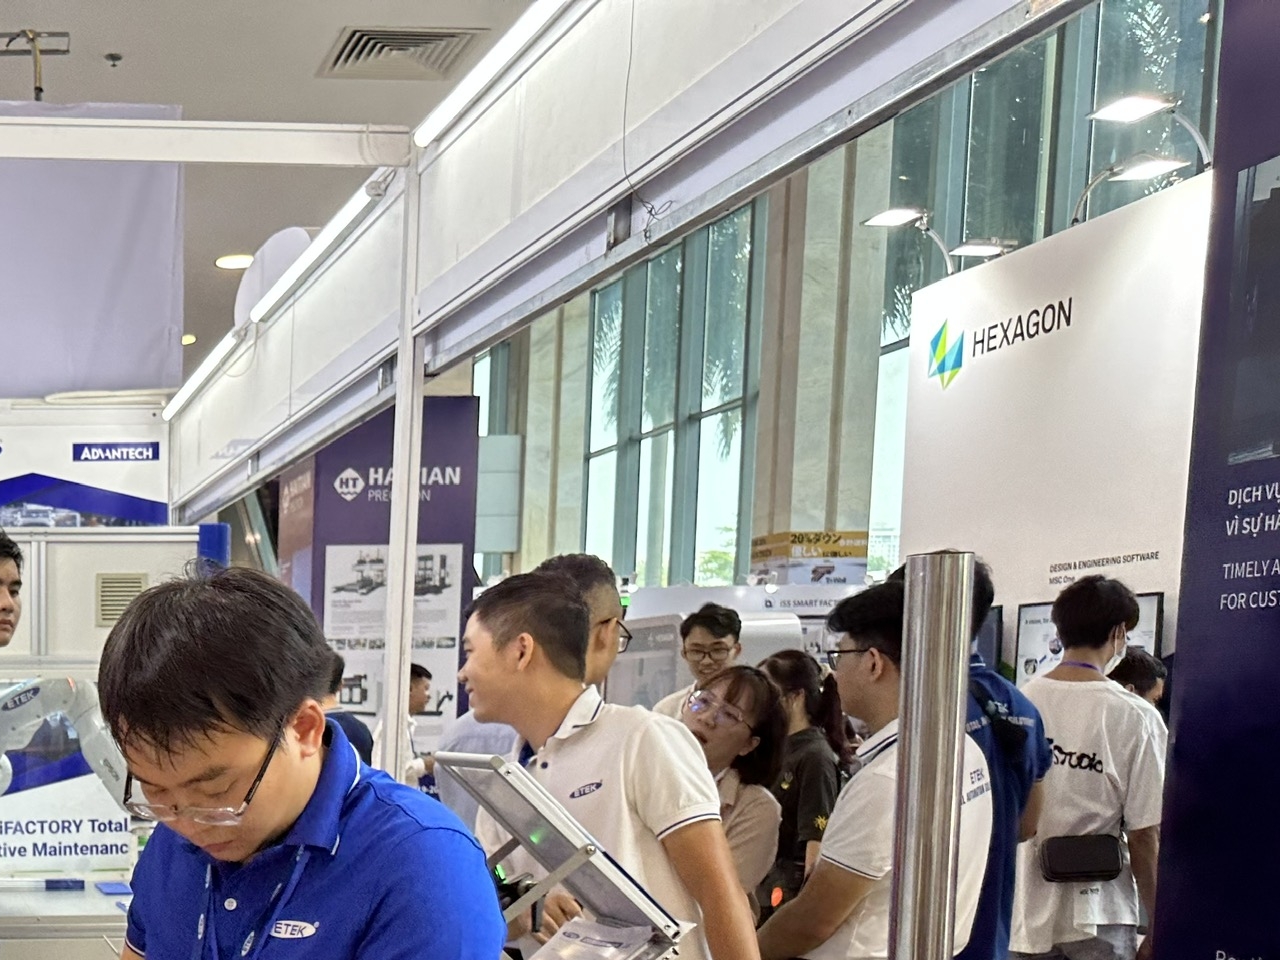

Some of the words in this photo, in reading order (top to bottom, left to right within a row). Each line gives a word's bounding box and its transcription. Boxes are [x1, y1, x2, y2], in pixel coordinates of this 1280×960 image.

[972, 297, 1072, 358] HEXAGON
[80, 446, 153, 460] ADVANTECH
[1228, 486, 1262, 509] DỊCH
[1050, 562, 1072, 573] DESIGN
[1122, 551, 1160, 563] SOFTWARE
[1223, 560, 1270, 579] TIMELY
[1220, 593, 1247, 610] FOR
[7, 691, 35, 708] ETEK
[572, 783, 597, 798] ETEK
[0, 819, 84, 835] iFACTORY
[88, 817, 128, 833] Total
[32, 842, 128, 857] Maintenanc
[274, 922, 306, 937] ETEK
